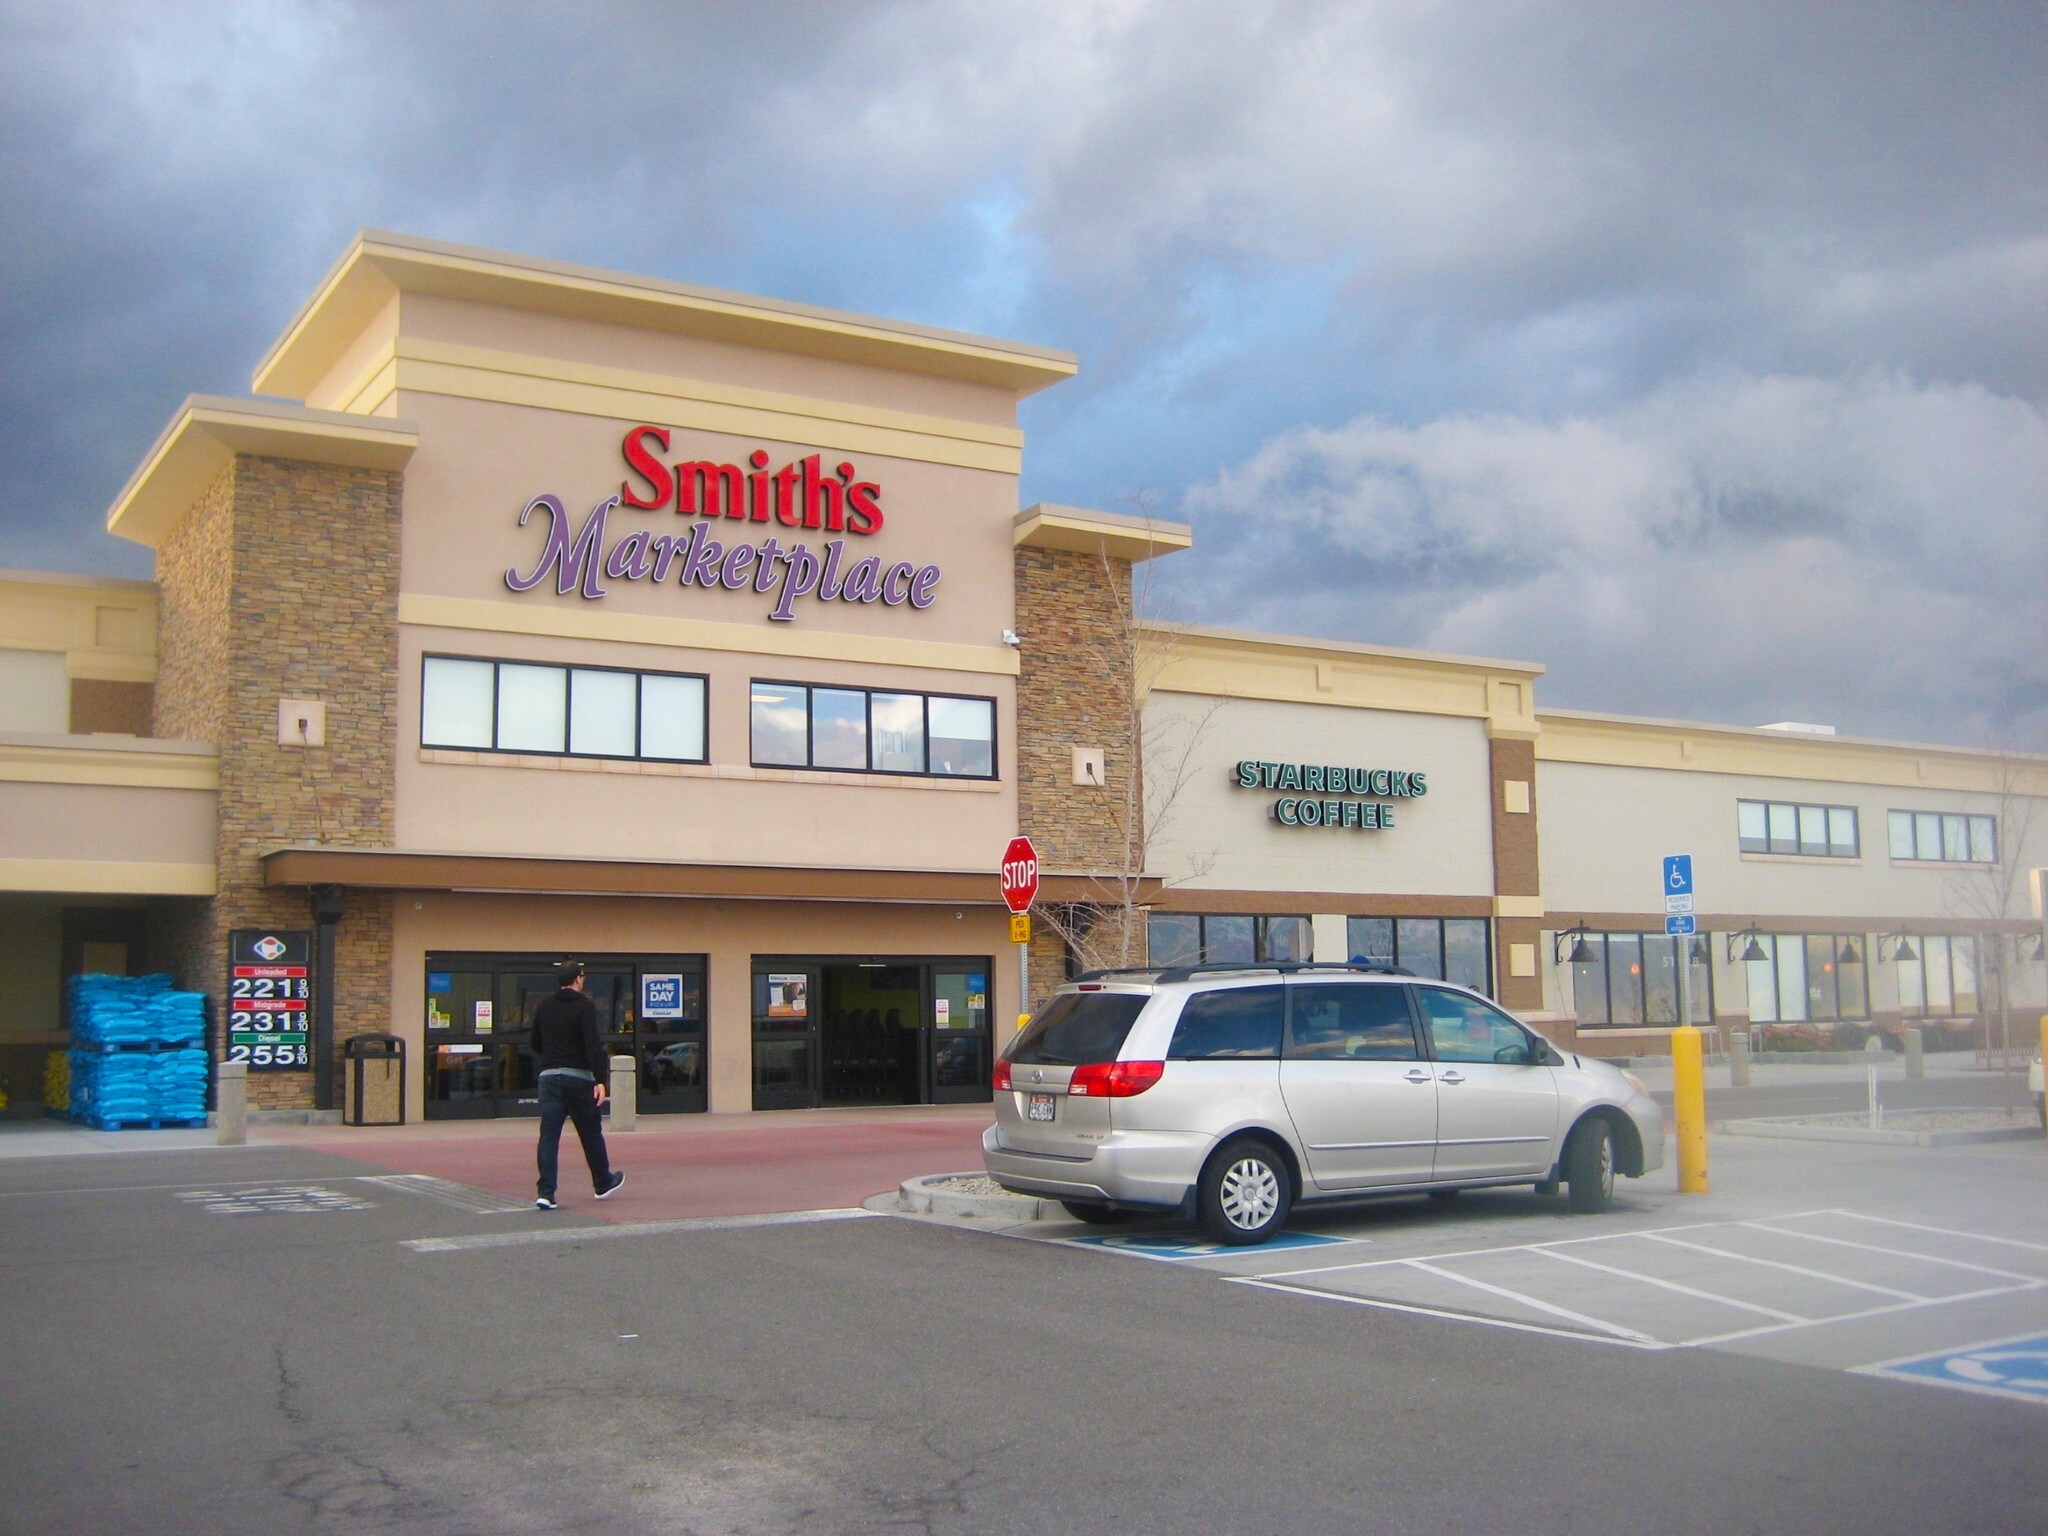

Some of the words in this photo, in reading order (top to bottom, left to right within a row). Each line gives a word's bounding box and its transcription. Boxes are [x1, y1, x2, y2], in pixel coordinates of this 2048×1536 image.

[621, 425, 884, 535] Smith's
[505, 492, 942, 621] Marketplace
[1237, 760, 1428, 798] STARBUCKS
[1275, 797, 1396, 829] COFFEE
[1003, 860, 1035, 890] STOP
[254, 968, 288, 977] Unleaded
[233, 978, 292, 998] 221
[650, 991, 674, 1001] DAY
[254, 1001, 286, 1010] Midgrade
[231, 1012, 291, 1031] 231
[258, 1034, 281, 1042] Diesel
[230, 1045, 295, 1065] 255
